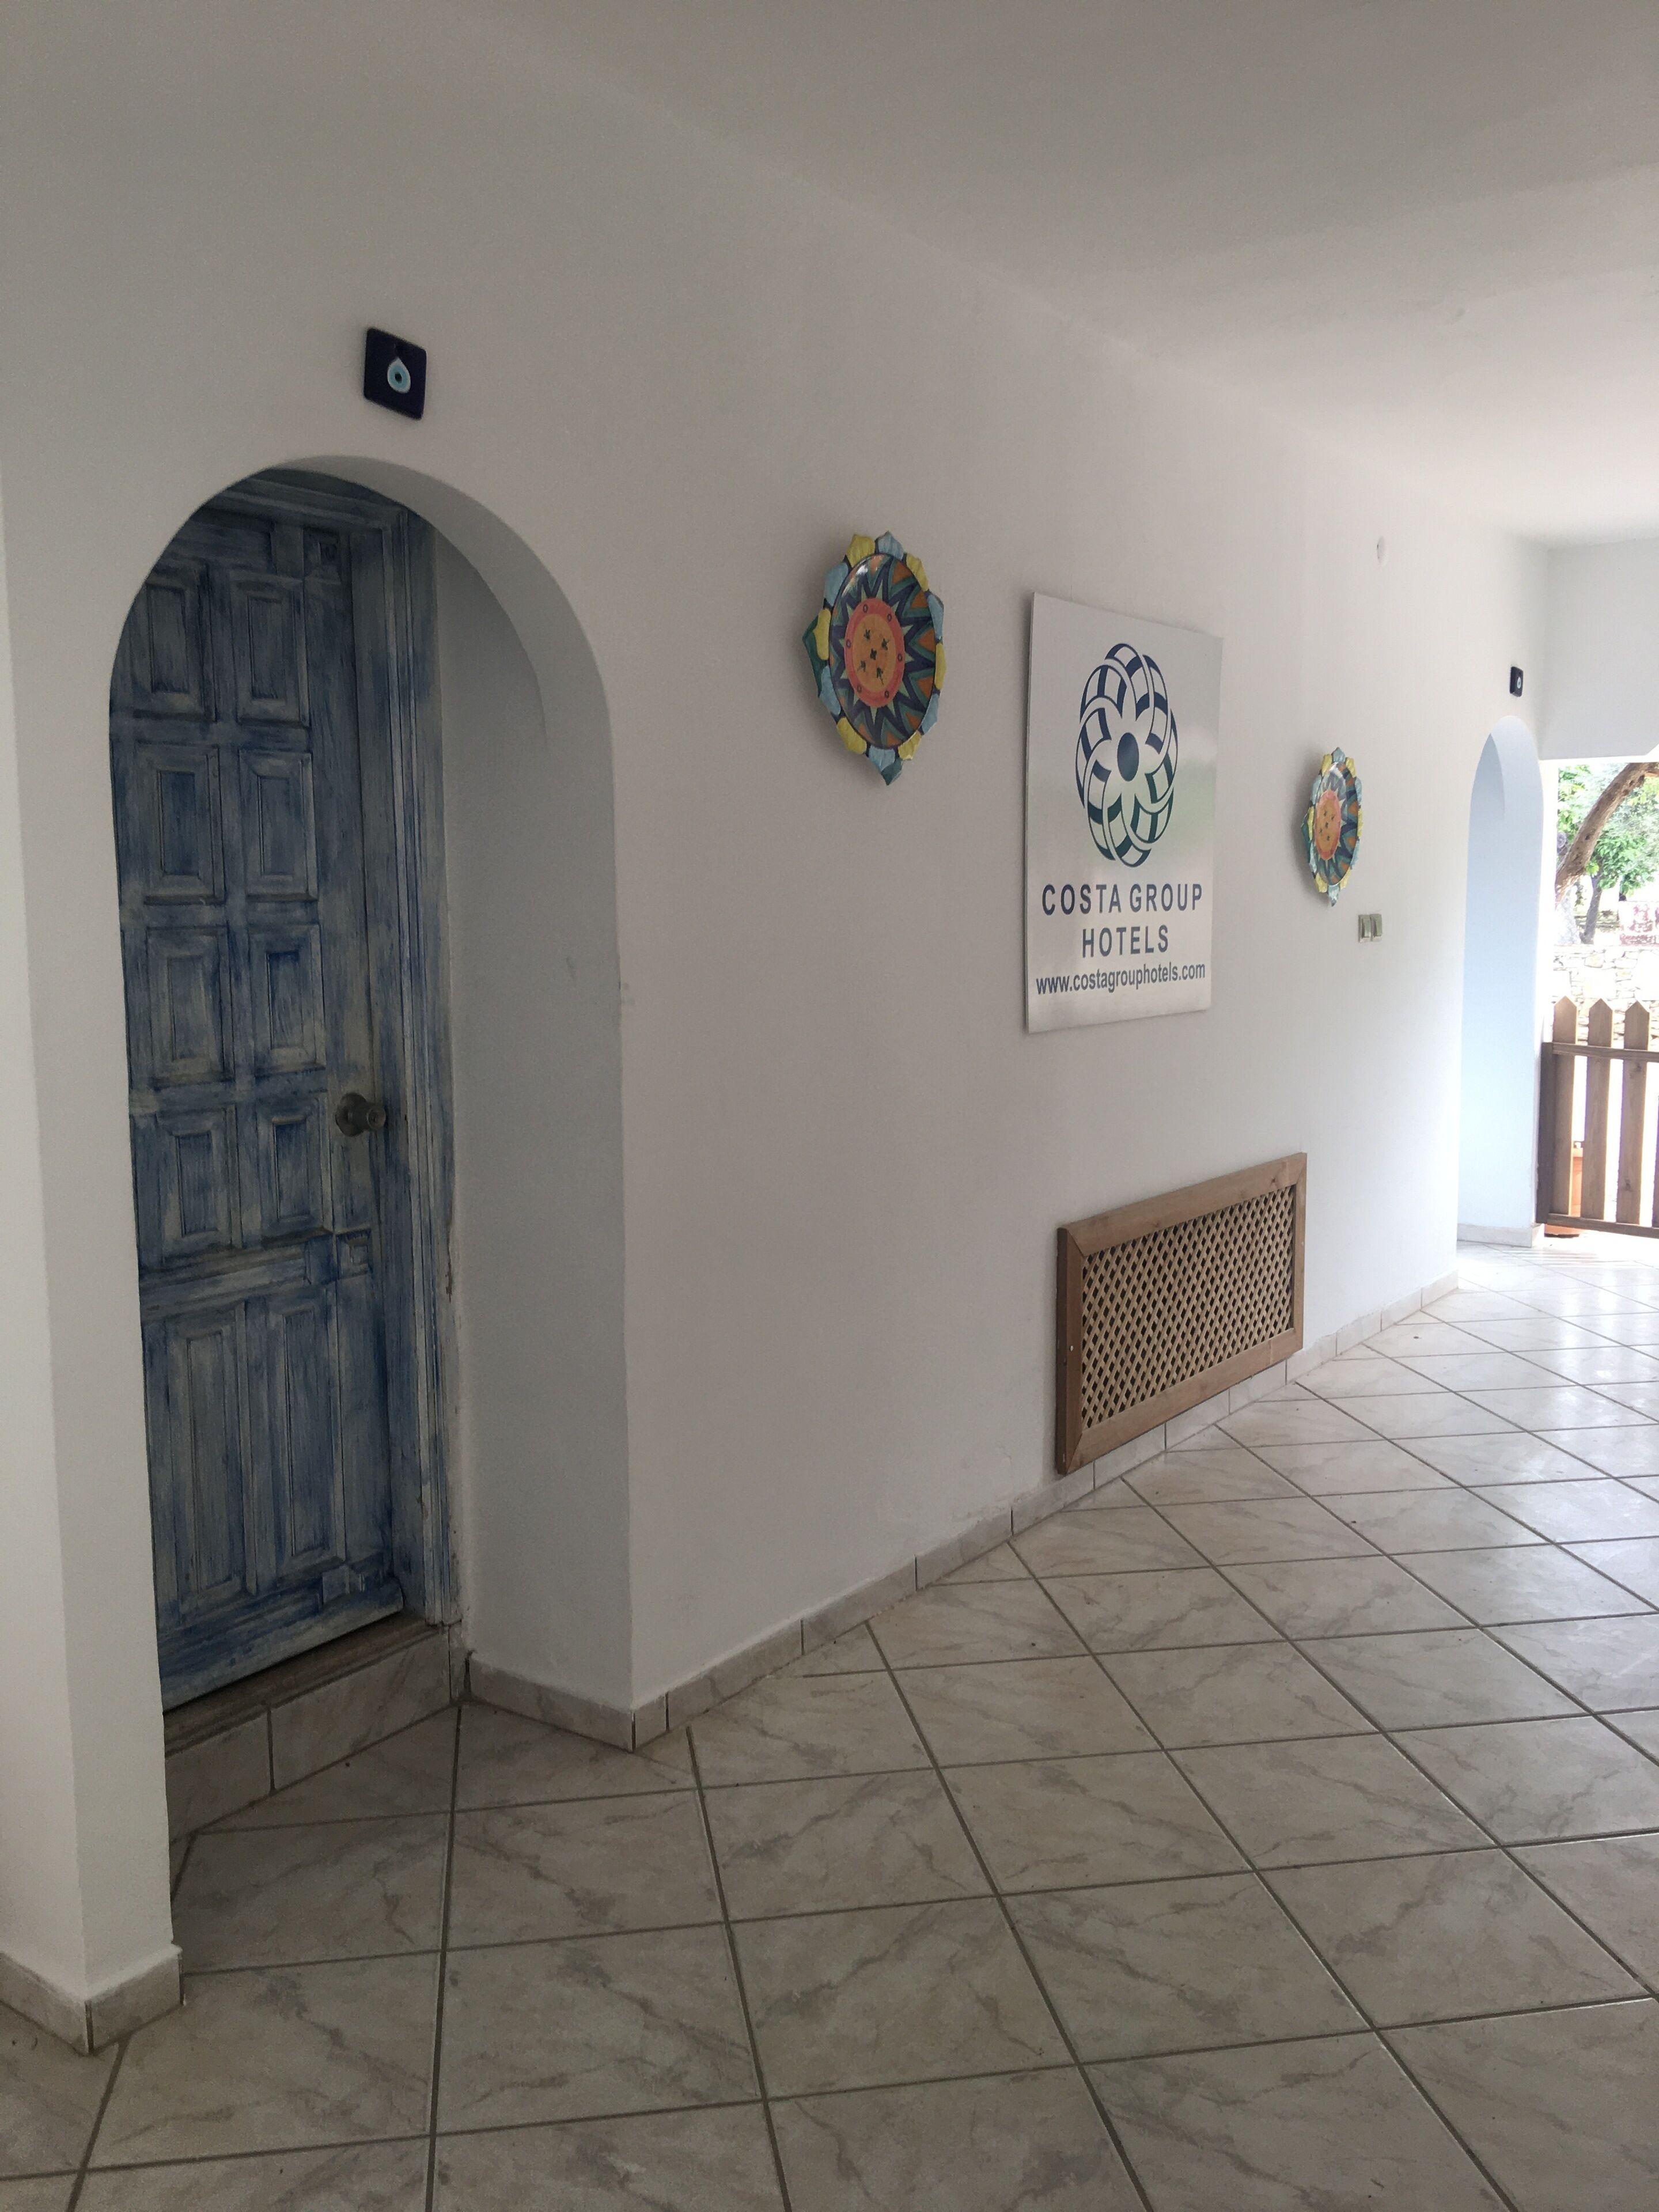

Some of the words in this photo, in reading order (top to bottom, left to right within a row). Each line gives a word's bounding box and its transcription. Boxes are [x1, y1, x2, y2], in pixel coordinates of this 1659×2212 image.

[1041, 883, 1122, 915] COSTA
[1129, 883, 1202, 912] GROUP
[1082, 924, 1169, 958] HOTELS
[1036, 961, 1206, 995] www.costagrouphotels.com
